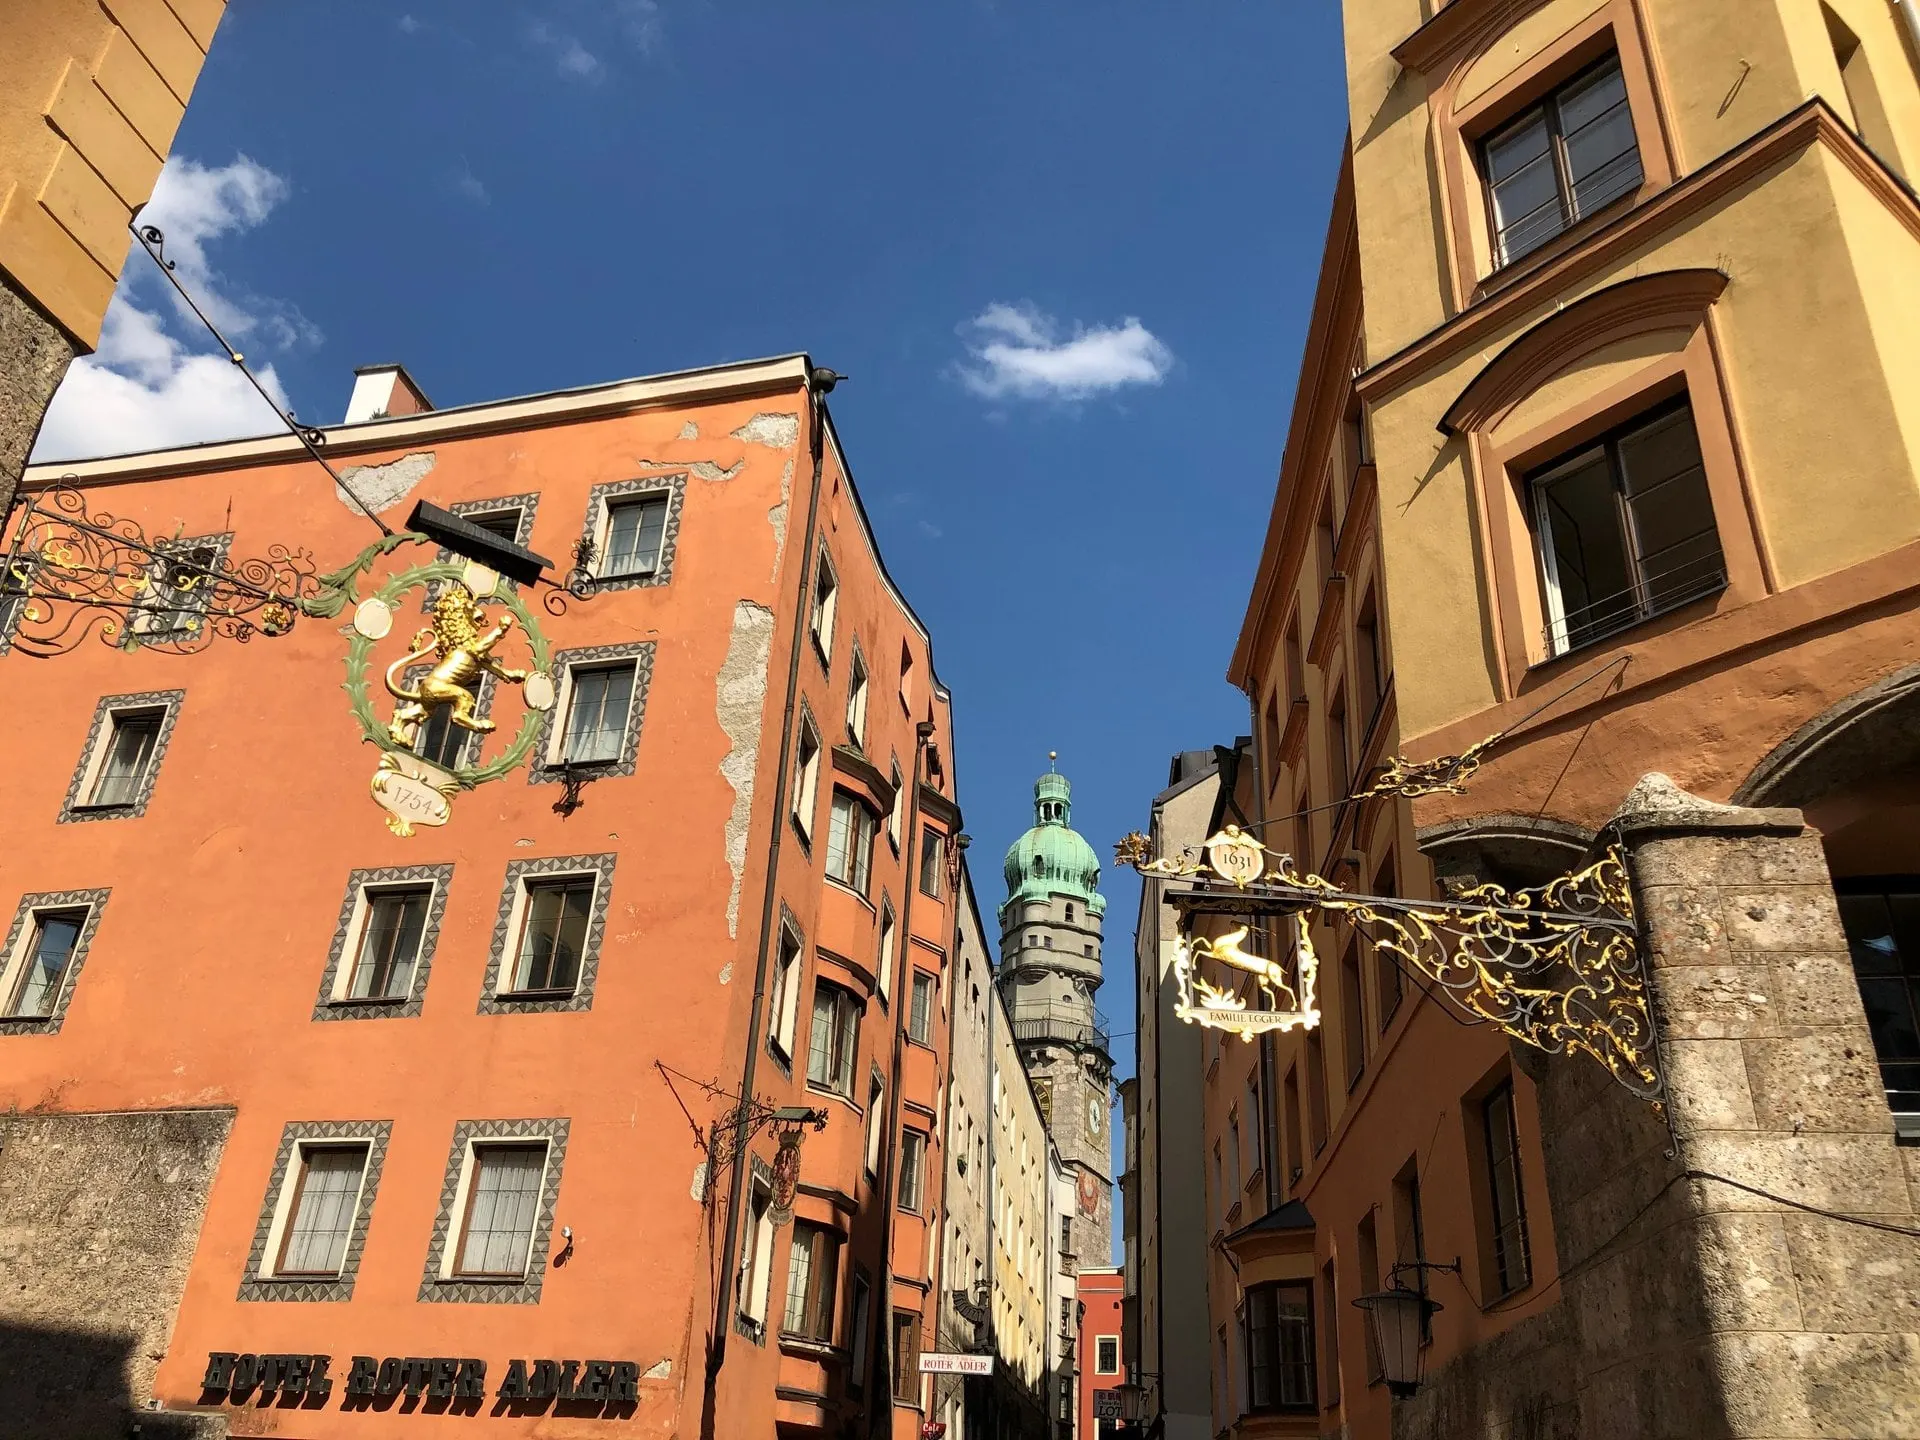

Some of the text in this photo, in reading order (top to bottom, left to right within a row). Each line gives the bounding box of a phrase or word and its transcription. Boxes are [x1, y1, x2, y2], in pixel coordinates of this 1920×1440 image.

[393, 786, 433, 815] 1754
[1223, 851, 1251, 871] 1631
[1209, 1012, 1283, 1024] FAMILIE EGGER
[923, 1359, 987, 1372] ROTER ADLER
[200, 1351, 641, 1402] HOTEL ROTER ADLER
